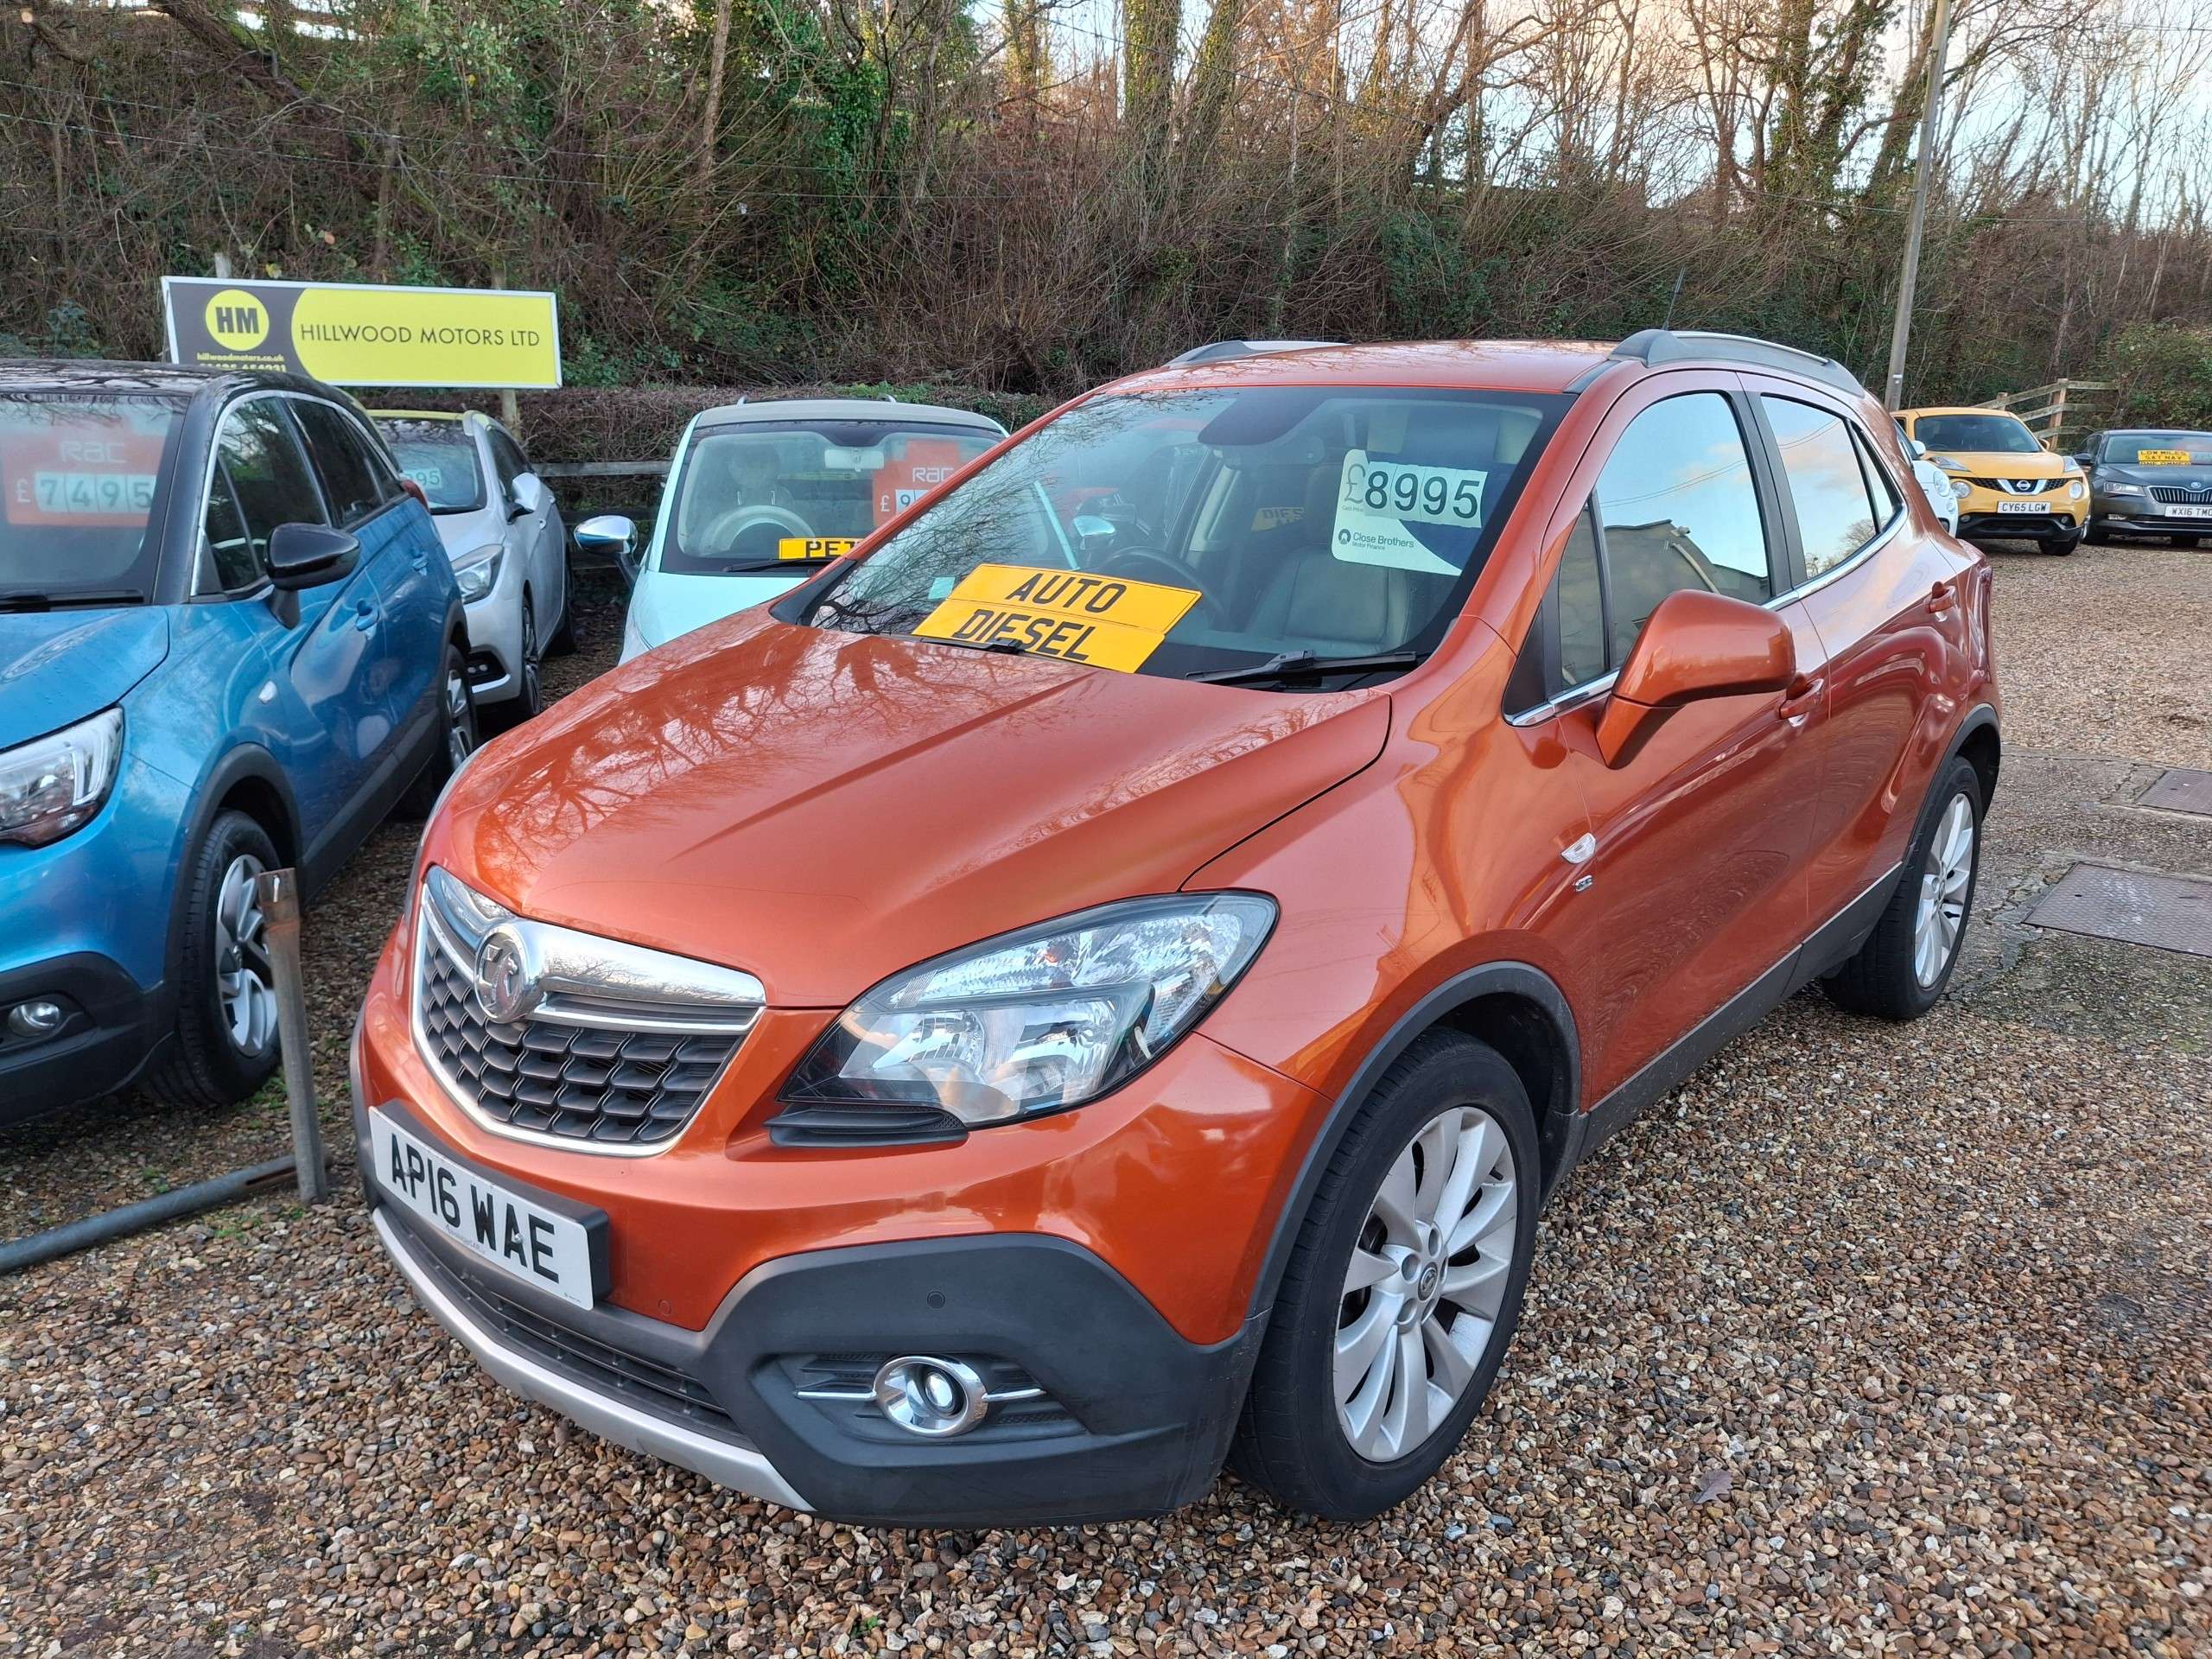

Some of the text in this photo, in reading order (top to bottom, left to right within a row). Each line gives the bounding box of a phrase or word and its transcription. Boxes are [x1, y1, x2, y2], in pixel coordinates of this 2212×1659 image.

[215, 307, 259, 334] HM
[301, 323, 539, 346] HILLWOOD MOTORS LTD
[2002, 503, 2047, 512] CY65 LGW
[2171, 507, 2193, 516] WX16
[1353, 531, 1414, 548] Close Brothers
[1005, 573, 1127, 613] AUTO
[950, 608, 1096, 661] DIESEL
[391, 1133, 559, 1284] AP16 WAE
